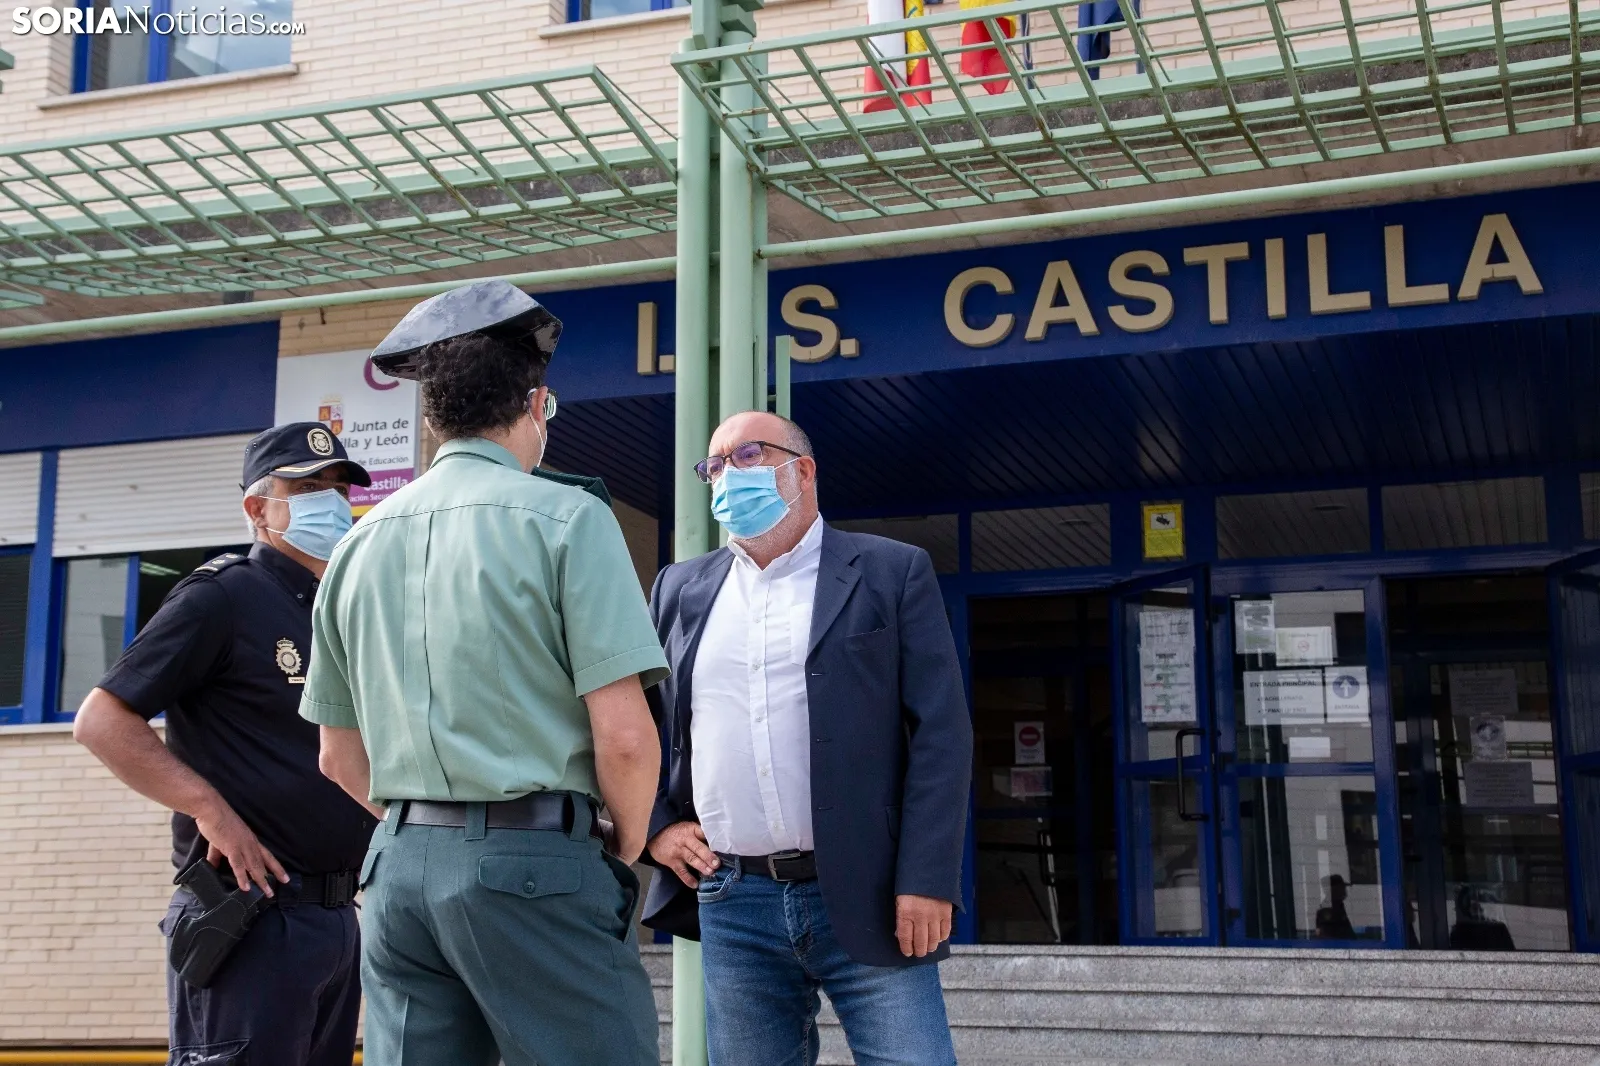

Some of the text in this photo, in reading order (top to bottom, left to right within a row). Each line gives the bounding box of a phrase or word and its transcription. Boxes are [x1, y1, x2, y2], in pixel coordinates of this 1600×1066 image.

[943, 212, 1545, 349] CASTILLA
[350, 418, 409, 433] Junta de
[363, 437, 372, 450] y
[376, 433, 409, 446] León
[363, 476, 408, 492] astilla
